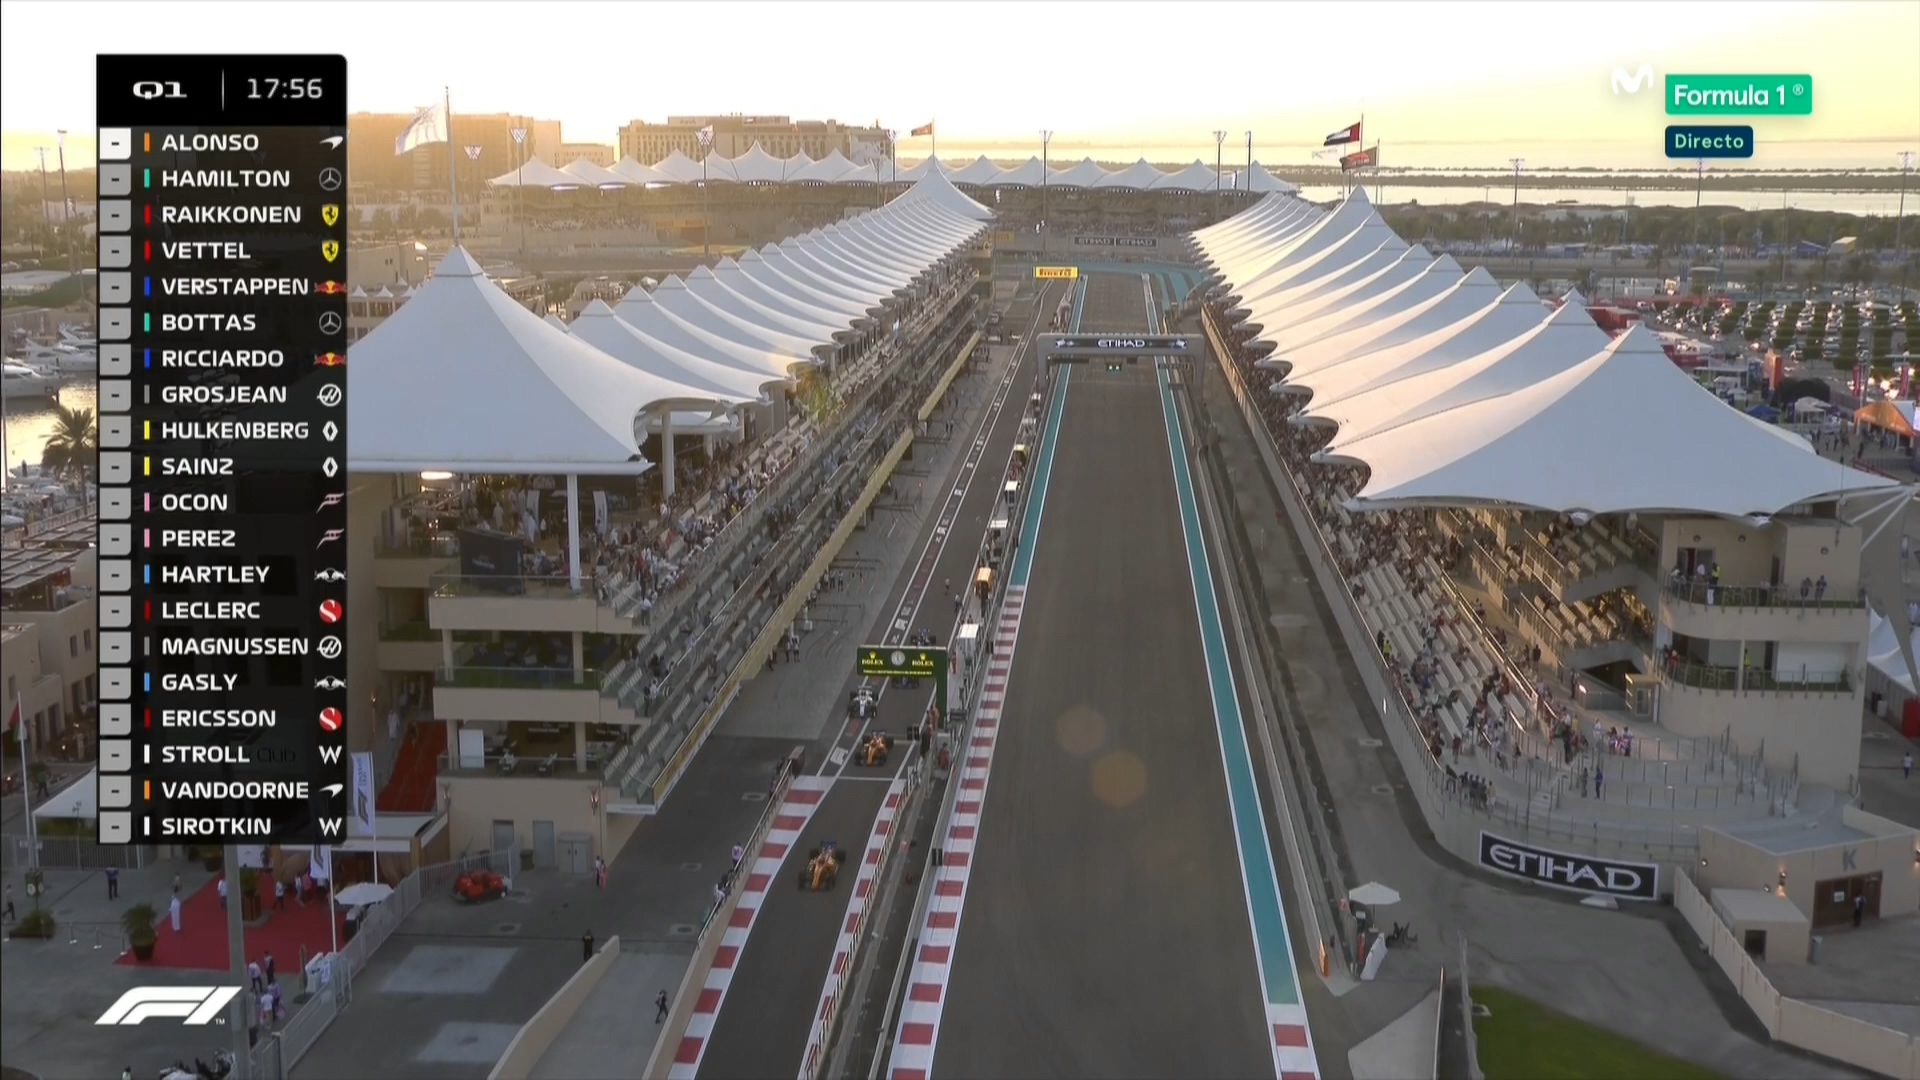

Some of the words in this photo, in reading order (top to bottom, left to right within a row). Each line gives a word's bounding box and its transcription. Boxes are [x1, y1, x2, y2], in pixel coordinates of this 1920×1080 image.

[1097, 339, 1146, 348] ETIHAD
[1488, 842, 1642, 892] ETIHAD
[1842, 849, 1858, 873] K
